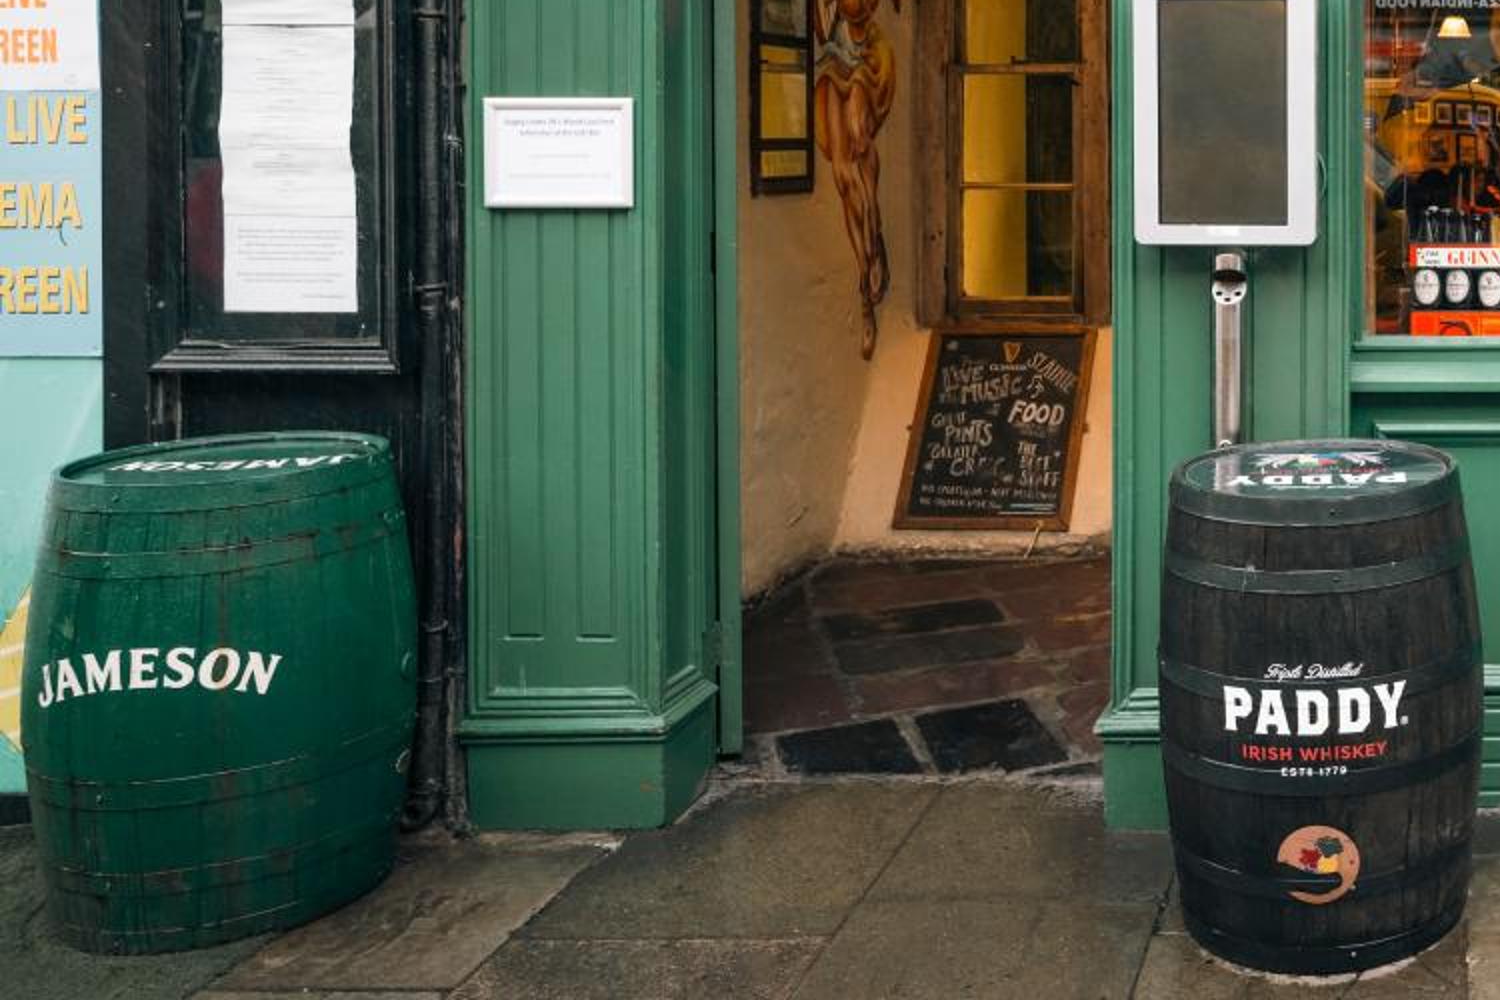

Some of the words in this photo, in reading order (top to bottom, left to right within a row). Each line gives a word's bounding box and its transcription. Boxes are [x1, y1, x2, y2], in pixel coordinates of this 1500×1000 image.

[6, 94, 88, 144] LIVE
[1008, 400, 1065, 425] FOOD
[944, 419, 993, 447] PINTS
[38, 647, 282, 708] JAMESON
[1241, 742, 1293, 761] IRISH
[1299, 738, 1390, 762] WHISKEY
